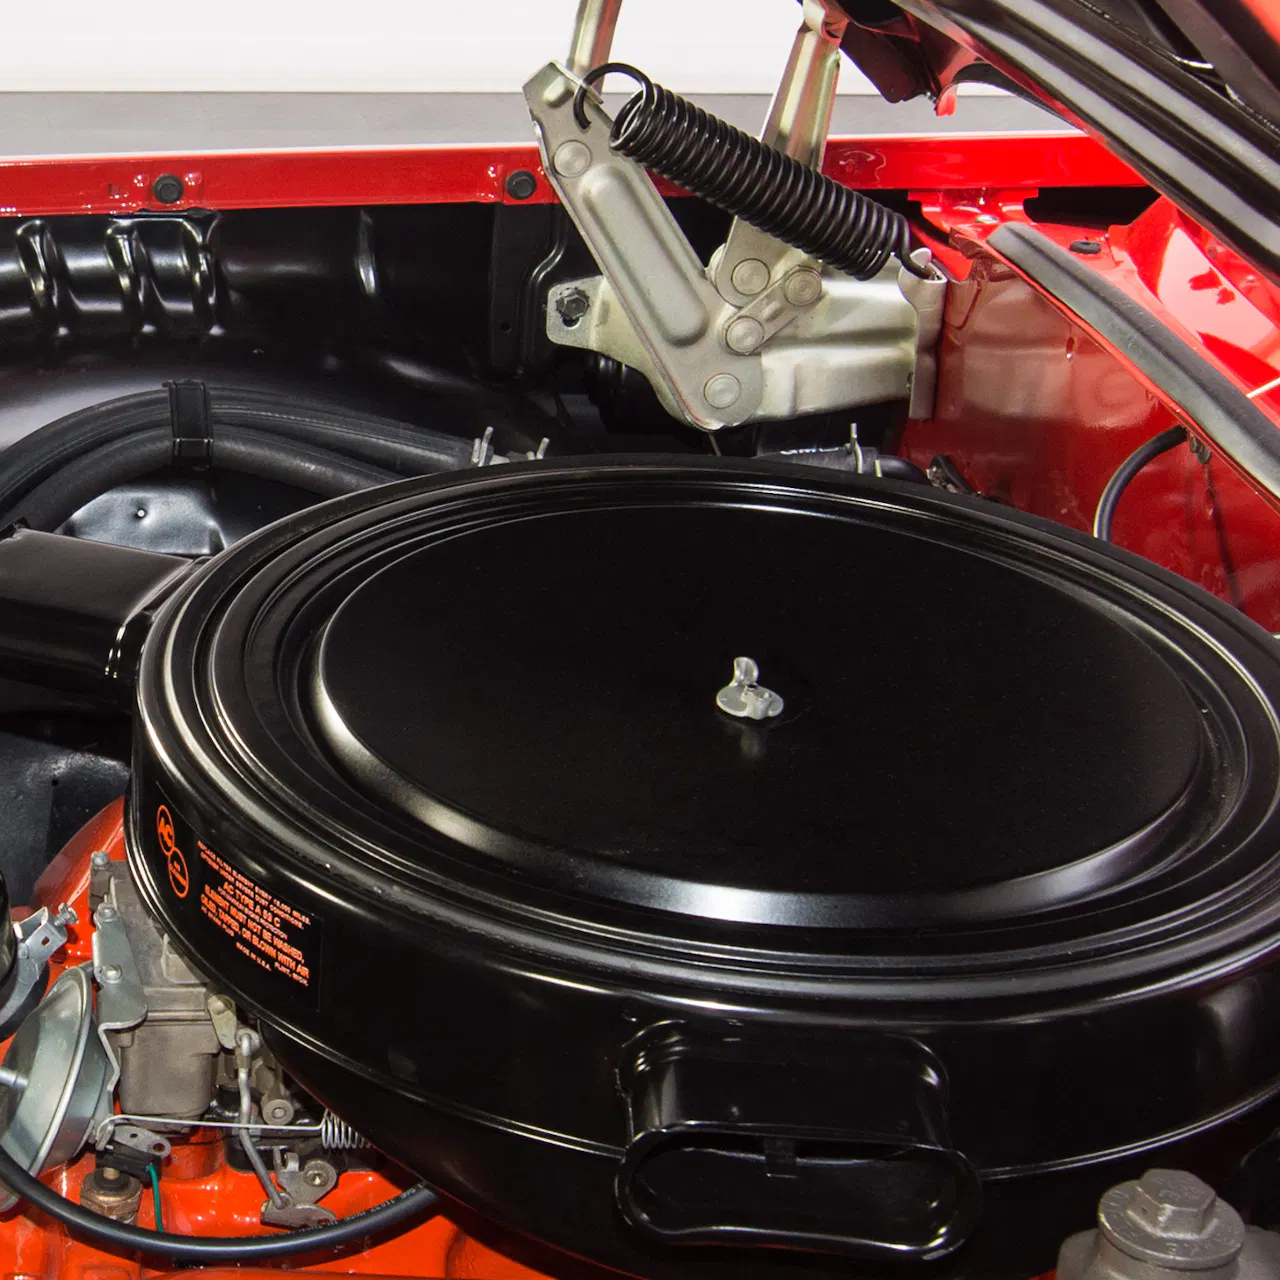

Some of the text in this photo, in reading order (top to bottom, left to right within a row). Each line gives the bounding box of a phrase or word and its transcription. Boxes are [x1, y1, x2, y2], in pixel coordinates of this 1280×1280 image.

[159, 816, 174, 847] AC
[204, 884, 229, 911] ELEMENT
[230, 906, 247, 924] MUST
[247, 919, 262, 935] NOT
[262, 928, 272, 943] BE
[223, 881, 234, 895] AC
[235, 889, 254, 911] TYPE
[255, 904, 262, 917] A
[241, 927, 252, 942] OR
[251, 934, 277, 959] BLOWN
[277, 951, 297, 971] WITH
[296, 964, 310, 979] AIR
